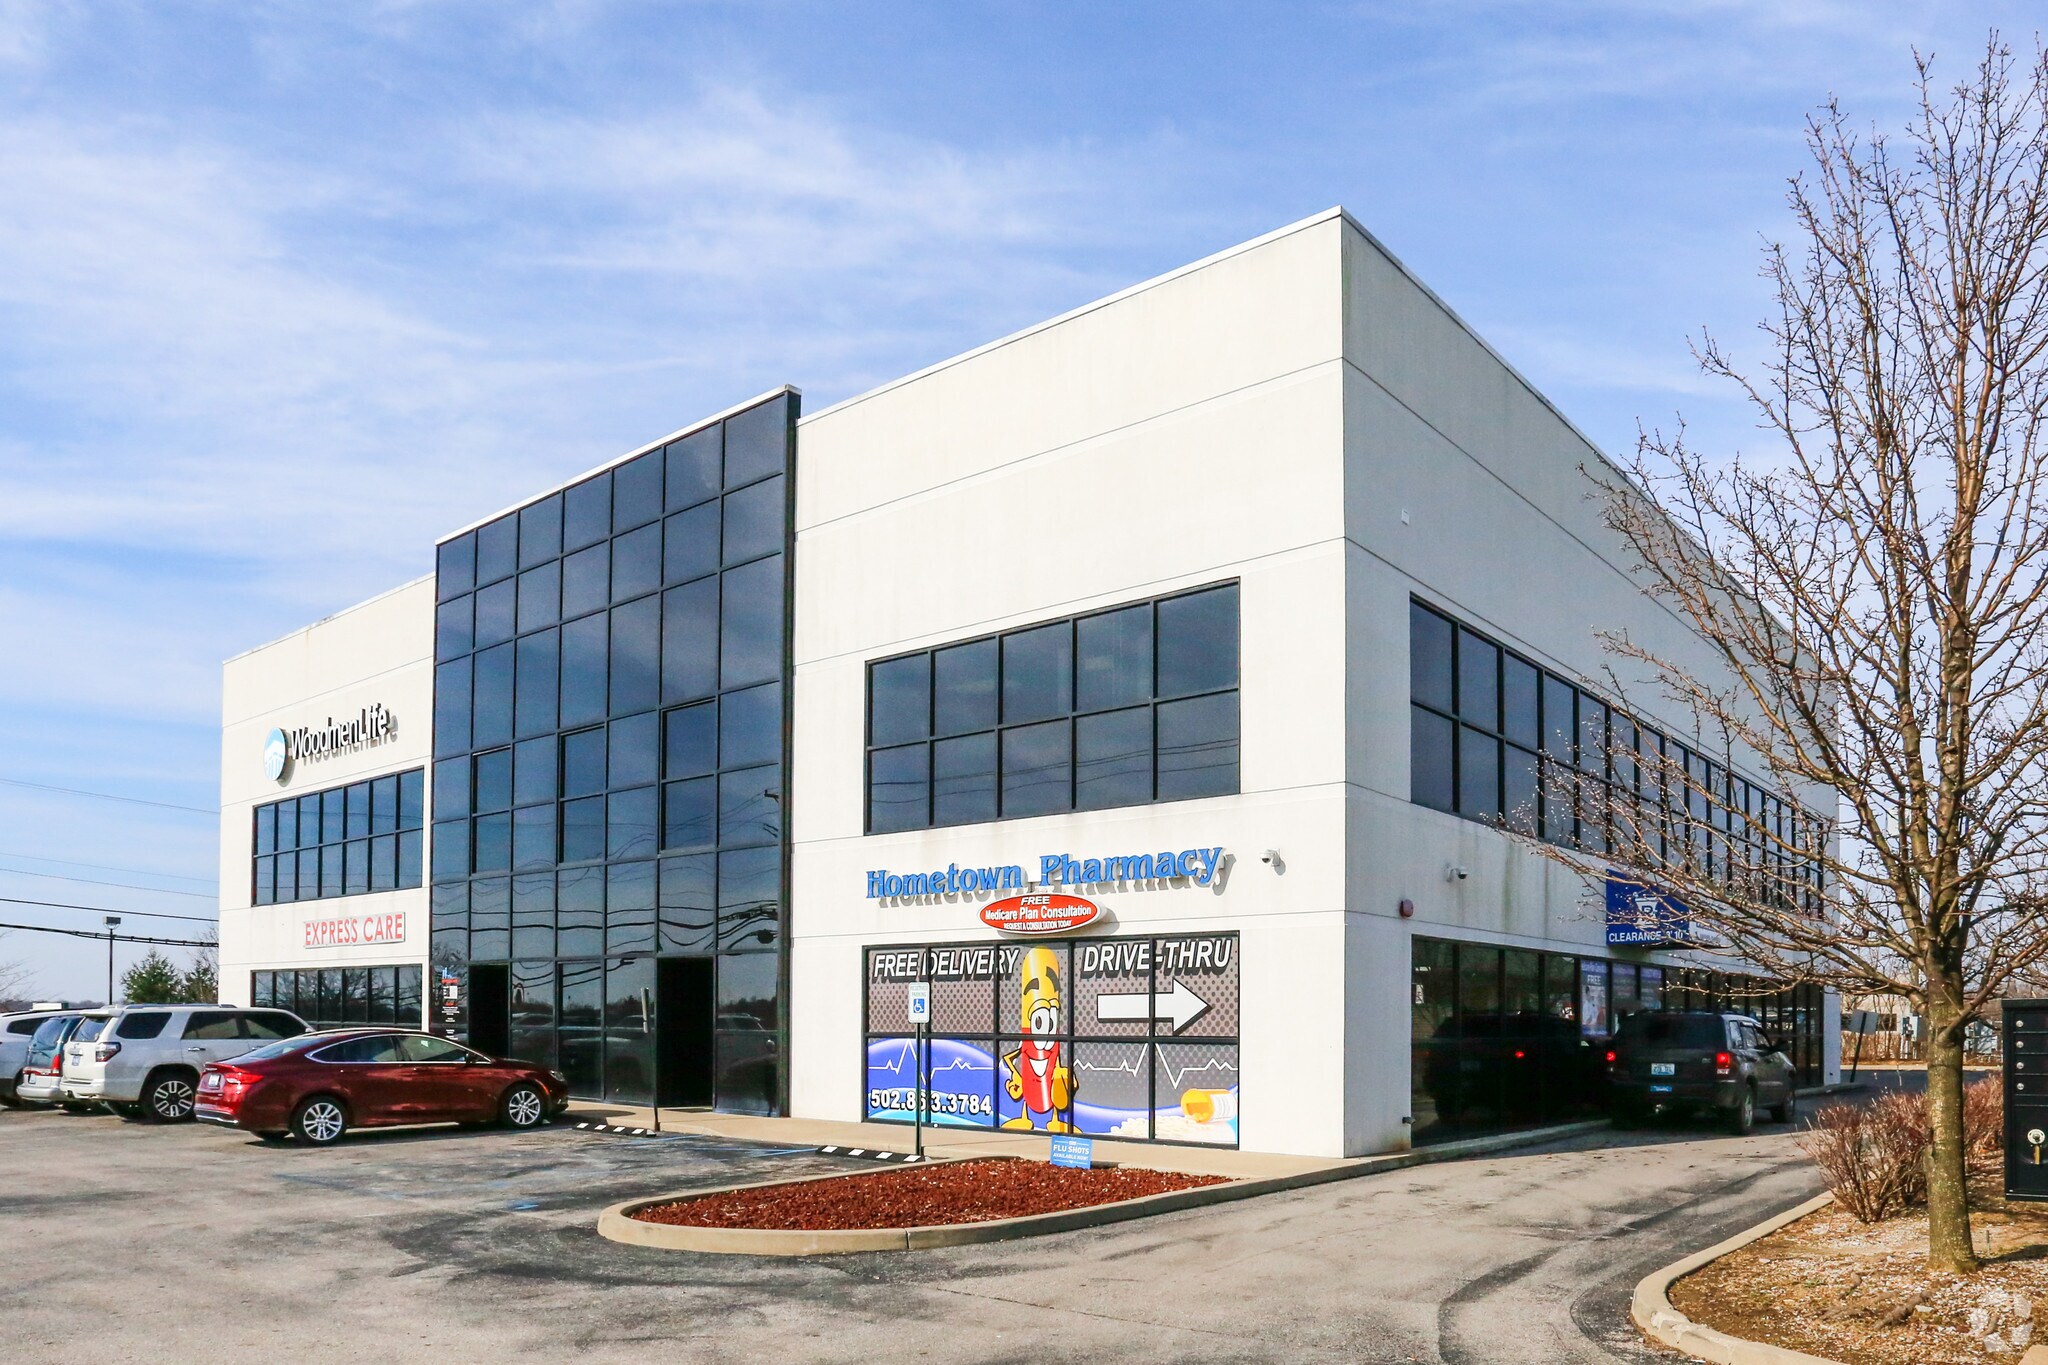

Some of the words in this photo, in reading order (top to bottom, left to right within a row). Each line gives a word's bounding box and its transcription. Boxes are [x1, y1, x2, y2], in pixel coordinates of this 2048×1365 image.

[291, 703, 389, 760] WoodmenLife
[866, 863, 1024, 898] Hometown
[1040, 847, 1224, 886] Pharmacy
[1020, 896, 1051, 906] FREE
[985, 908, 1018, 920] Medicare
[1019, 906, 1039, 920] Plan
[1040, 904, 1092, 919] Consultation
[305, 917, 358, 946] EXPRESS
[363, 913, 404, 942] CARE
[1003, 922, 1023, 930] REQUEST
[1027, 920, 1058, 931] CONSULTATION
[1058, 919, 1073, 929] TODAY
[1608, 930, 1662, 943] CLEARANCE
[873, 951, 919, 978] FREE
[921, 949, 1020, 976] DELIVERY
[1083, 939, 1232, 973] DRIVE-THRU
[1587, 974, 1602, 986] FREE
[870, 1088, 992, 1115] 502.863.3784
[1053, 1144, 1067, 1153] FLU
[1067, 1145, 1090, 1155] SHOTS
